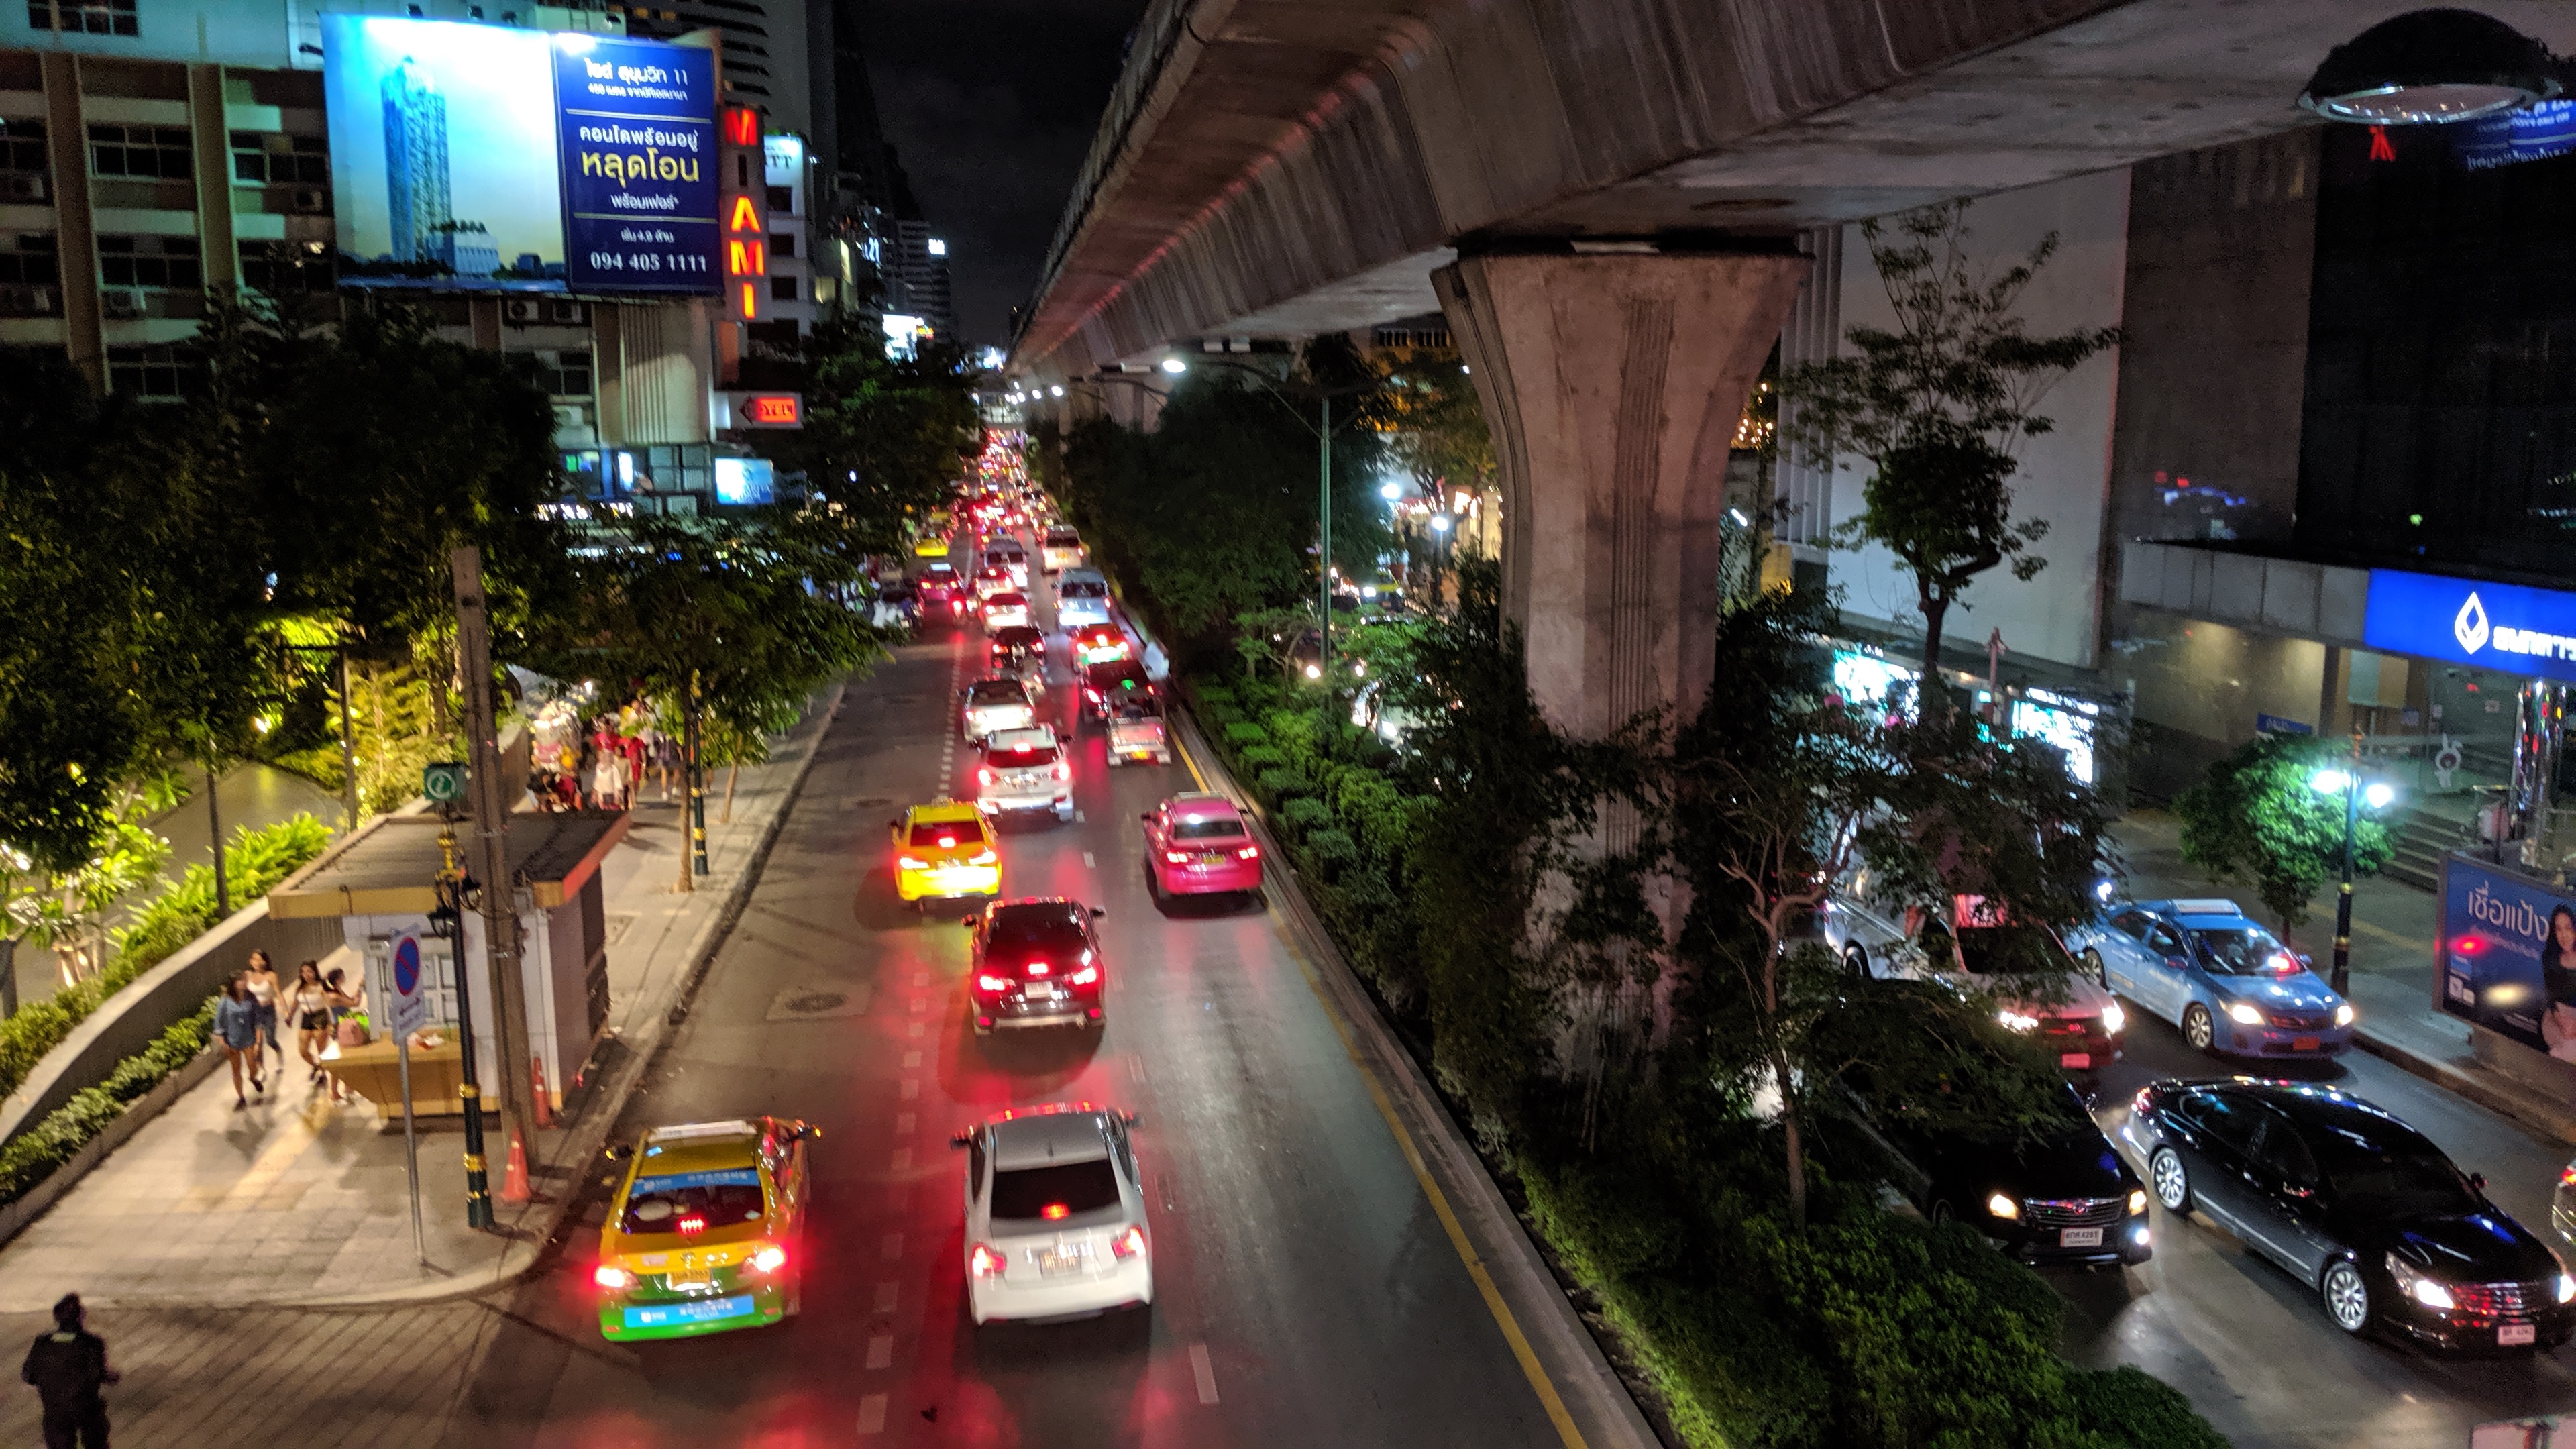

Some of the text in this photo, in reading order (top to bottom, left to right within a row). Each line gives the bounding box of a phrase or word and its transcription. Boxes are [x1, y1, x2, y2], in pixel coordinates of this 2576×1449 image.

[618, 65, 667, 85] สุขุมวิท
[673, 68, 688, 85] 11
[580, 124, 698, 152] คอนโดพร้อมอยู่
[581, 146, 699, 189] หลุดโอน
[724, 109, 765, 319] MIAMI
[590, 251, 706, 272] 094 405 1111
[2468, 880, 2550, 942] เชื่อแป้ง
